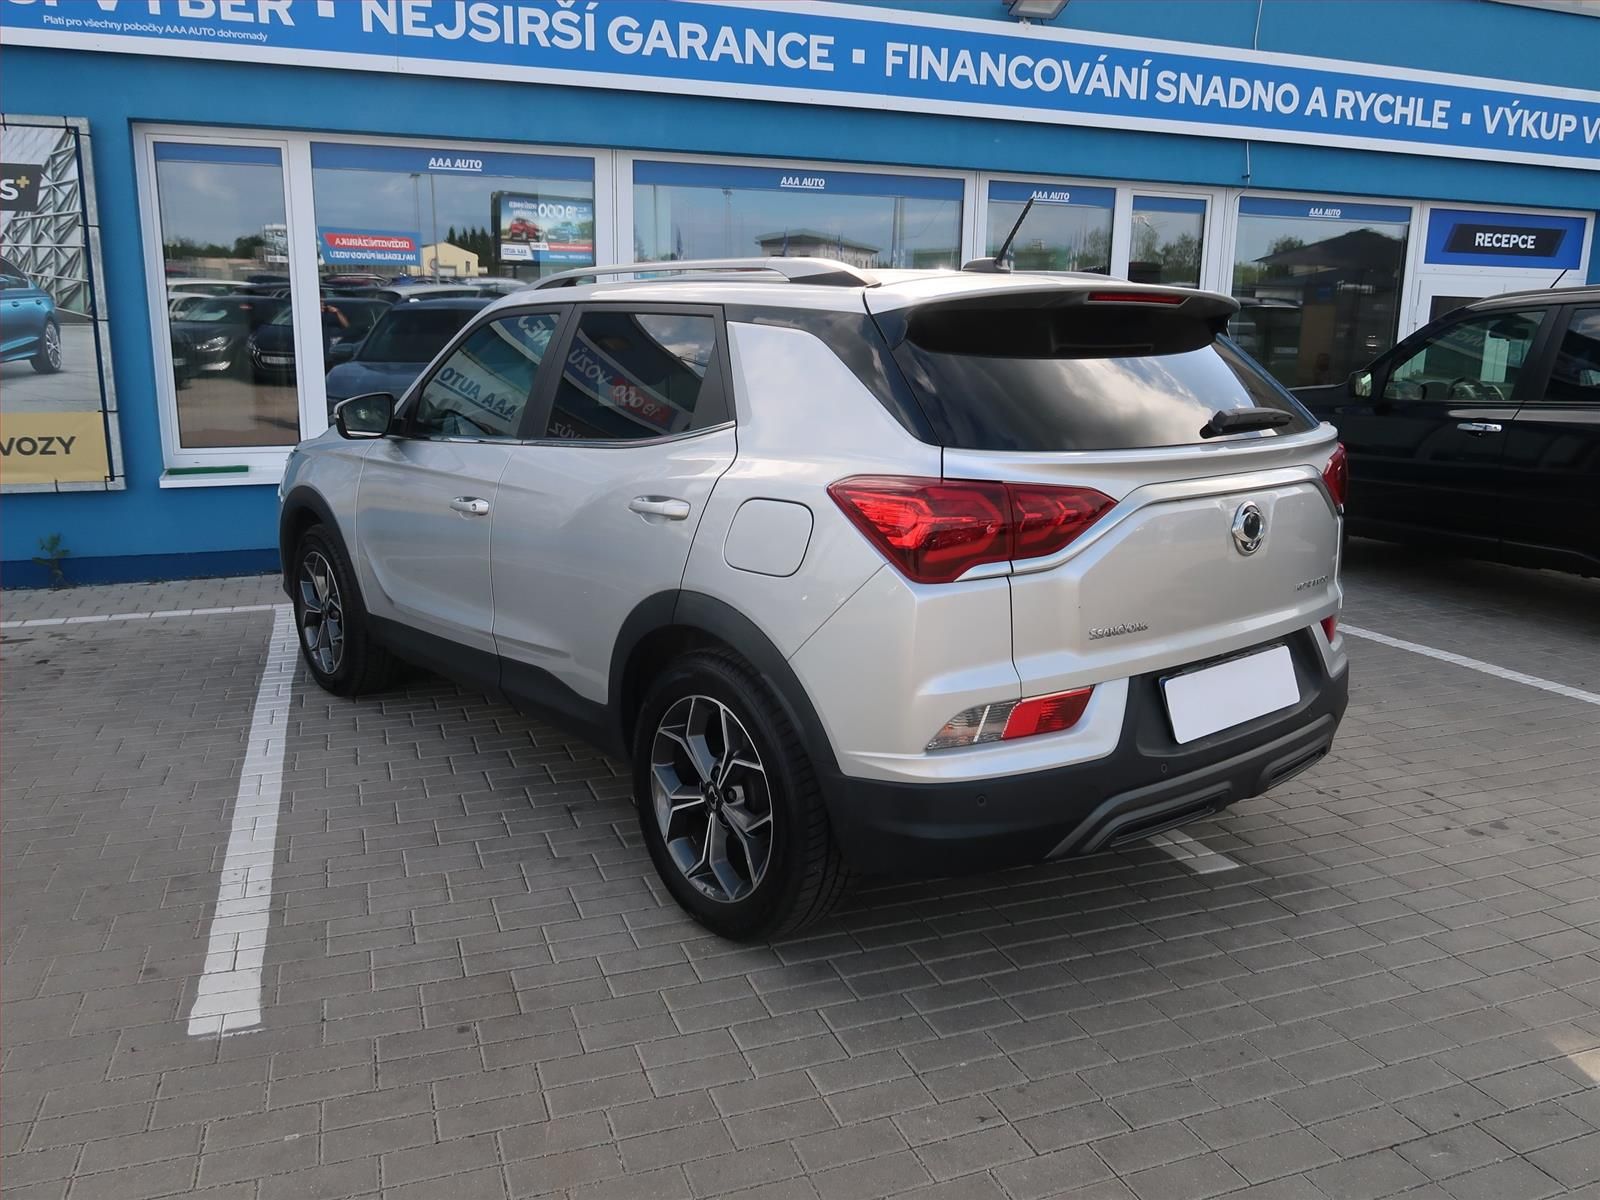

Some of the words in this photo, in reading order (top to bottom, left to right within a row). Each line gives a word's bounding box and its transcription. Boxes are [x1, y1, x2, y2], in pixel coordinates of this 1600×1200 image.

[43, 15, 65, 26] Platí
[65, 18, 82, 28] pro
[83, 19, 122, 32] všechny
[122, 22, 163, 35] pobočky
[165, 25, 188, 35] AAA
[188, 27, 216, 37] AUTO
[217, 30, 268, 43] dohromady
[607, 15, 835, 72] GARANCE
[886, 41, 1153, 101] FINANCOVÁNÍ
[1155, 70, 1300, 115] SNADNO
[1304, 86, 1328, 118] A
[1334, 89, 1451, 130] RYCHLE
[1482, 99, 1578, 142] VÝKUP
[429, 157, 452, 169] AAA
[454, 158, 483, 170] AUTO
[780, 176, 800, 187] AAA
[802, 177, 825, 188] AUTO
[1031, 190, 1048, 200] AAA
[1050, 191, 1070, 201] AUTO
[1309, 207, 1323, 217] AAA
[1324, 208, 1342, 218] AUTO
[1473, 231, 1537, 250] RECEPCE
